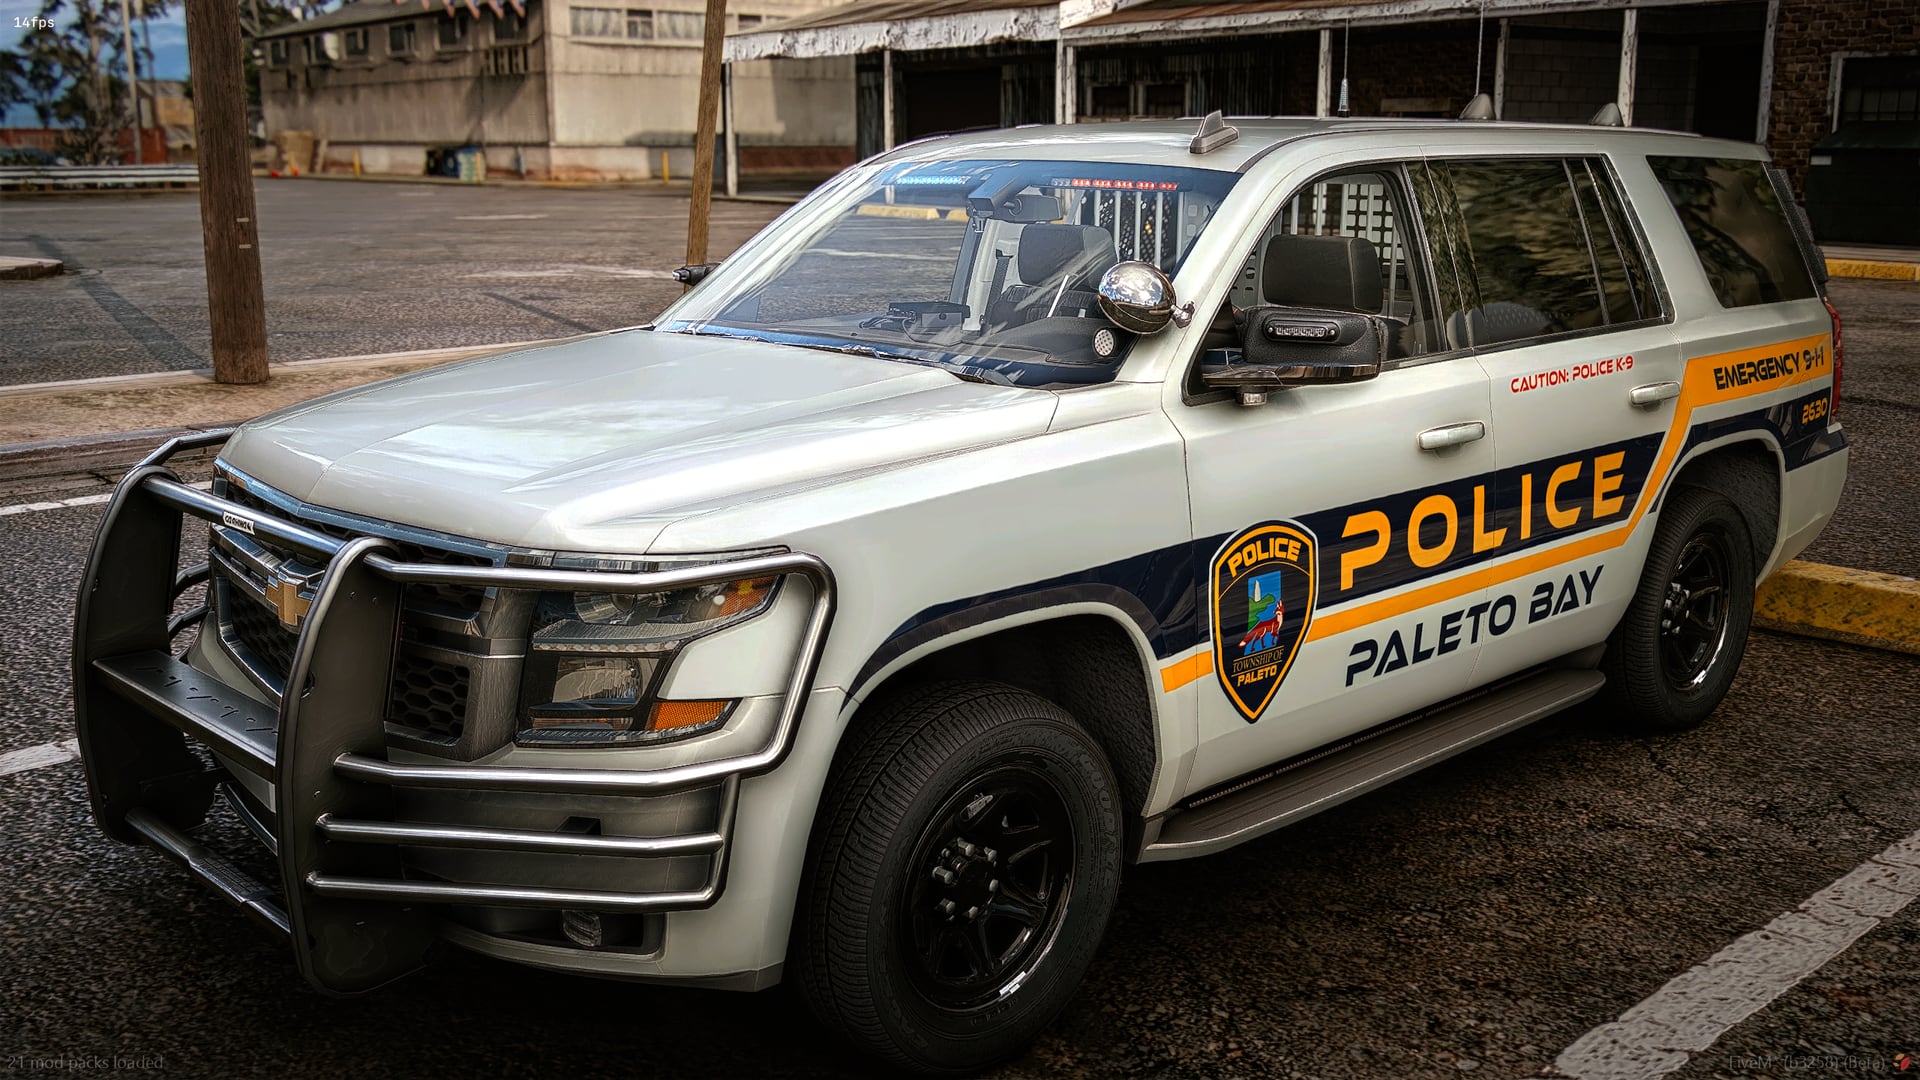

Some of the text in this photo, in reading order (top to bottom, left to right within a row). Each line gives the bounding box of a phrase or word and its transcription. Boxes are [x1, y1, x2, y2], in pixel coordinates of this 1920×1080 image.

[1510, 355, 1634, 393] CAUTION: POLICE K-9
[1713, 351, 1800, 390] EMERGENCY
[1802, 397, 1828, 424] 2630
[1340, 450, 1626, 591] POLICE
[1227, 537, 1301, 578] POLICE
[1345, 564, 1605, 687] PALETO BAY
[1233, 648, 1284, 673] TOWNSHIP OF
[1237, 664, 1278, 688] PALETO
